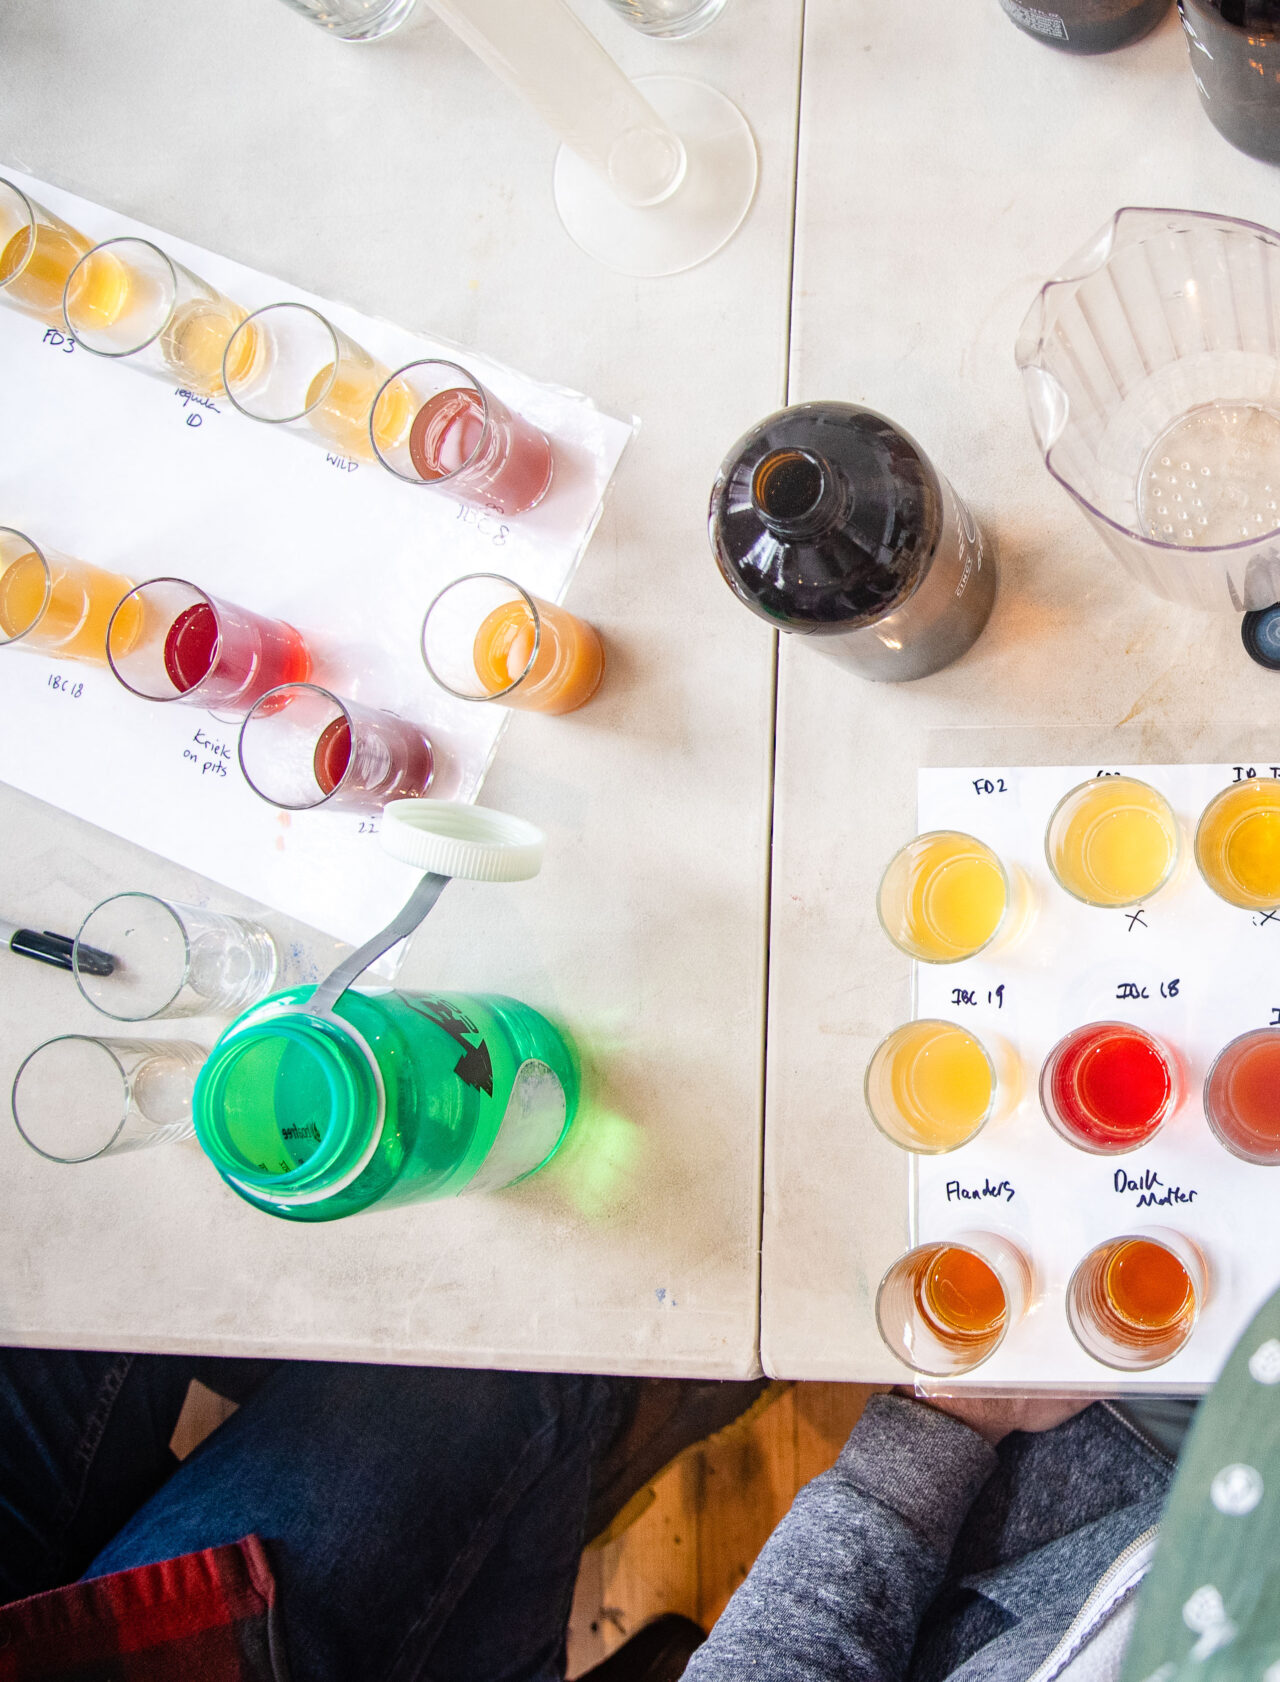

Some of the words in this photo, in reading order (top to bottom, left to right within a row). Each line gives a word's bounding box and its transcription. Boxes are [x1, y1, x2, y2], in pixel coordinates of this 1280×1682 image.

[43, 329, 76, 353] FD3
[326, 453, 359, 472] WILD
[192, 729, 231, 759] Kriek
[183, 750, 198, 763] on
[972, 778, 1008, 795] FD2
[951, 987, 978, 1006] IBC
[987, 984, 1005, 1008] 19
[1160, 979, 1181, 998] 18
[945, 1178, 1016, 1202] Flanders
[1136, 1189, 1199, 1208] Matter
